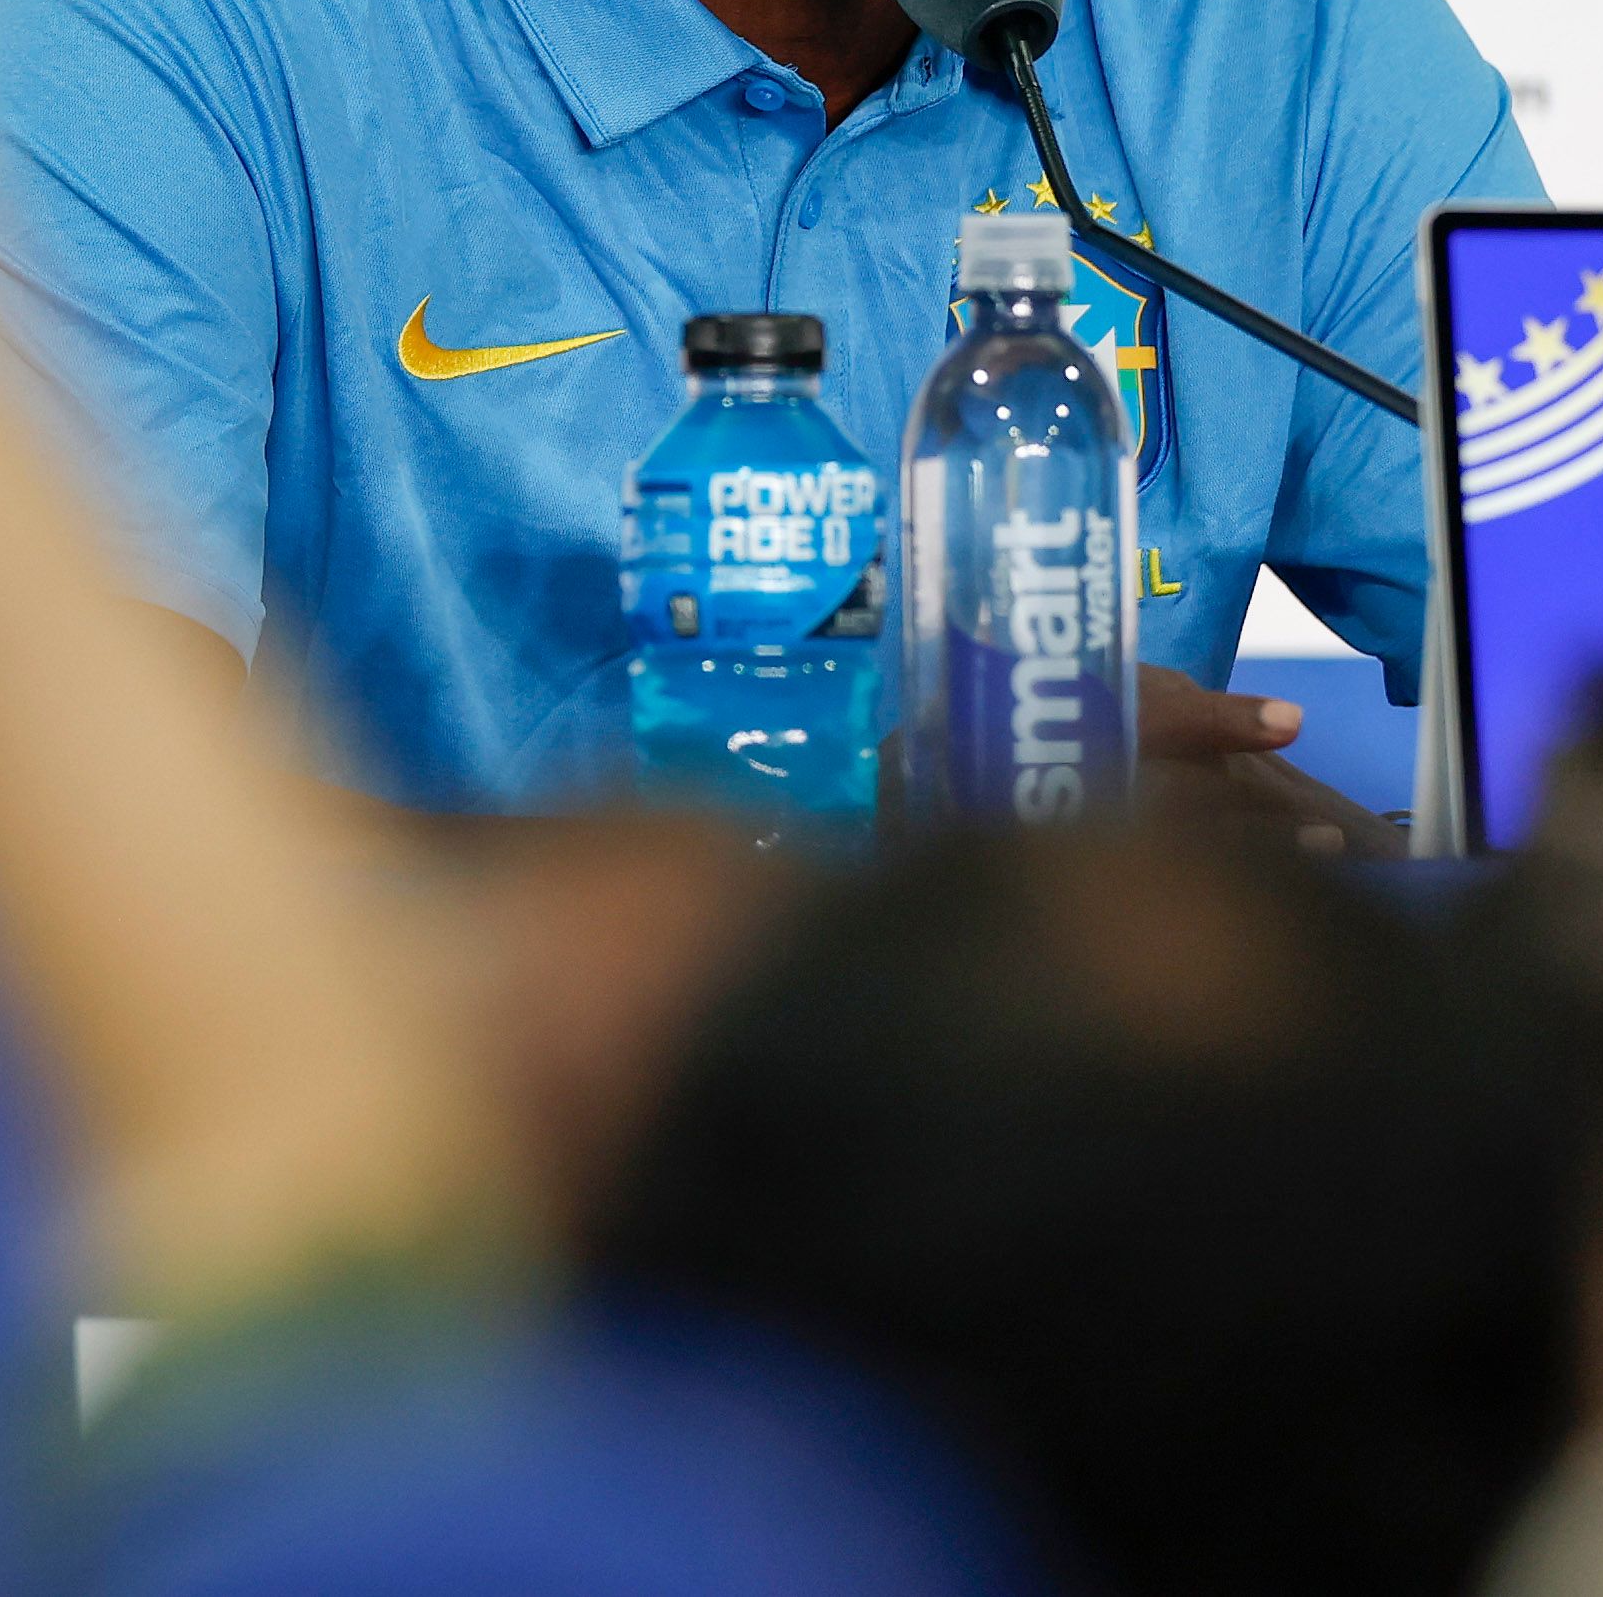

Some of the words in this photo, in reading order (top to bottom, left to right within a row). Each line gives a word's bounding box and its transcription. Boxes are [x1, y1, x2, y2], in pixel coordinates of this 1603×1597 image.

[708, 470, 876, 517] POWER
[708, 515, 817, 562] ADE
[1083, 506, 1114, 650] water
[993, 507, 1083, 827] smart
